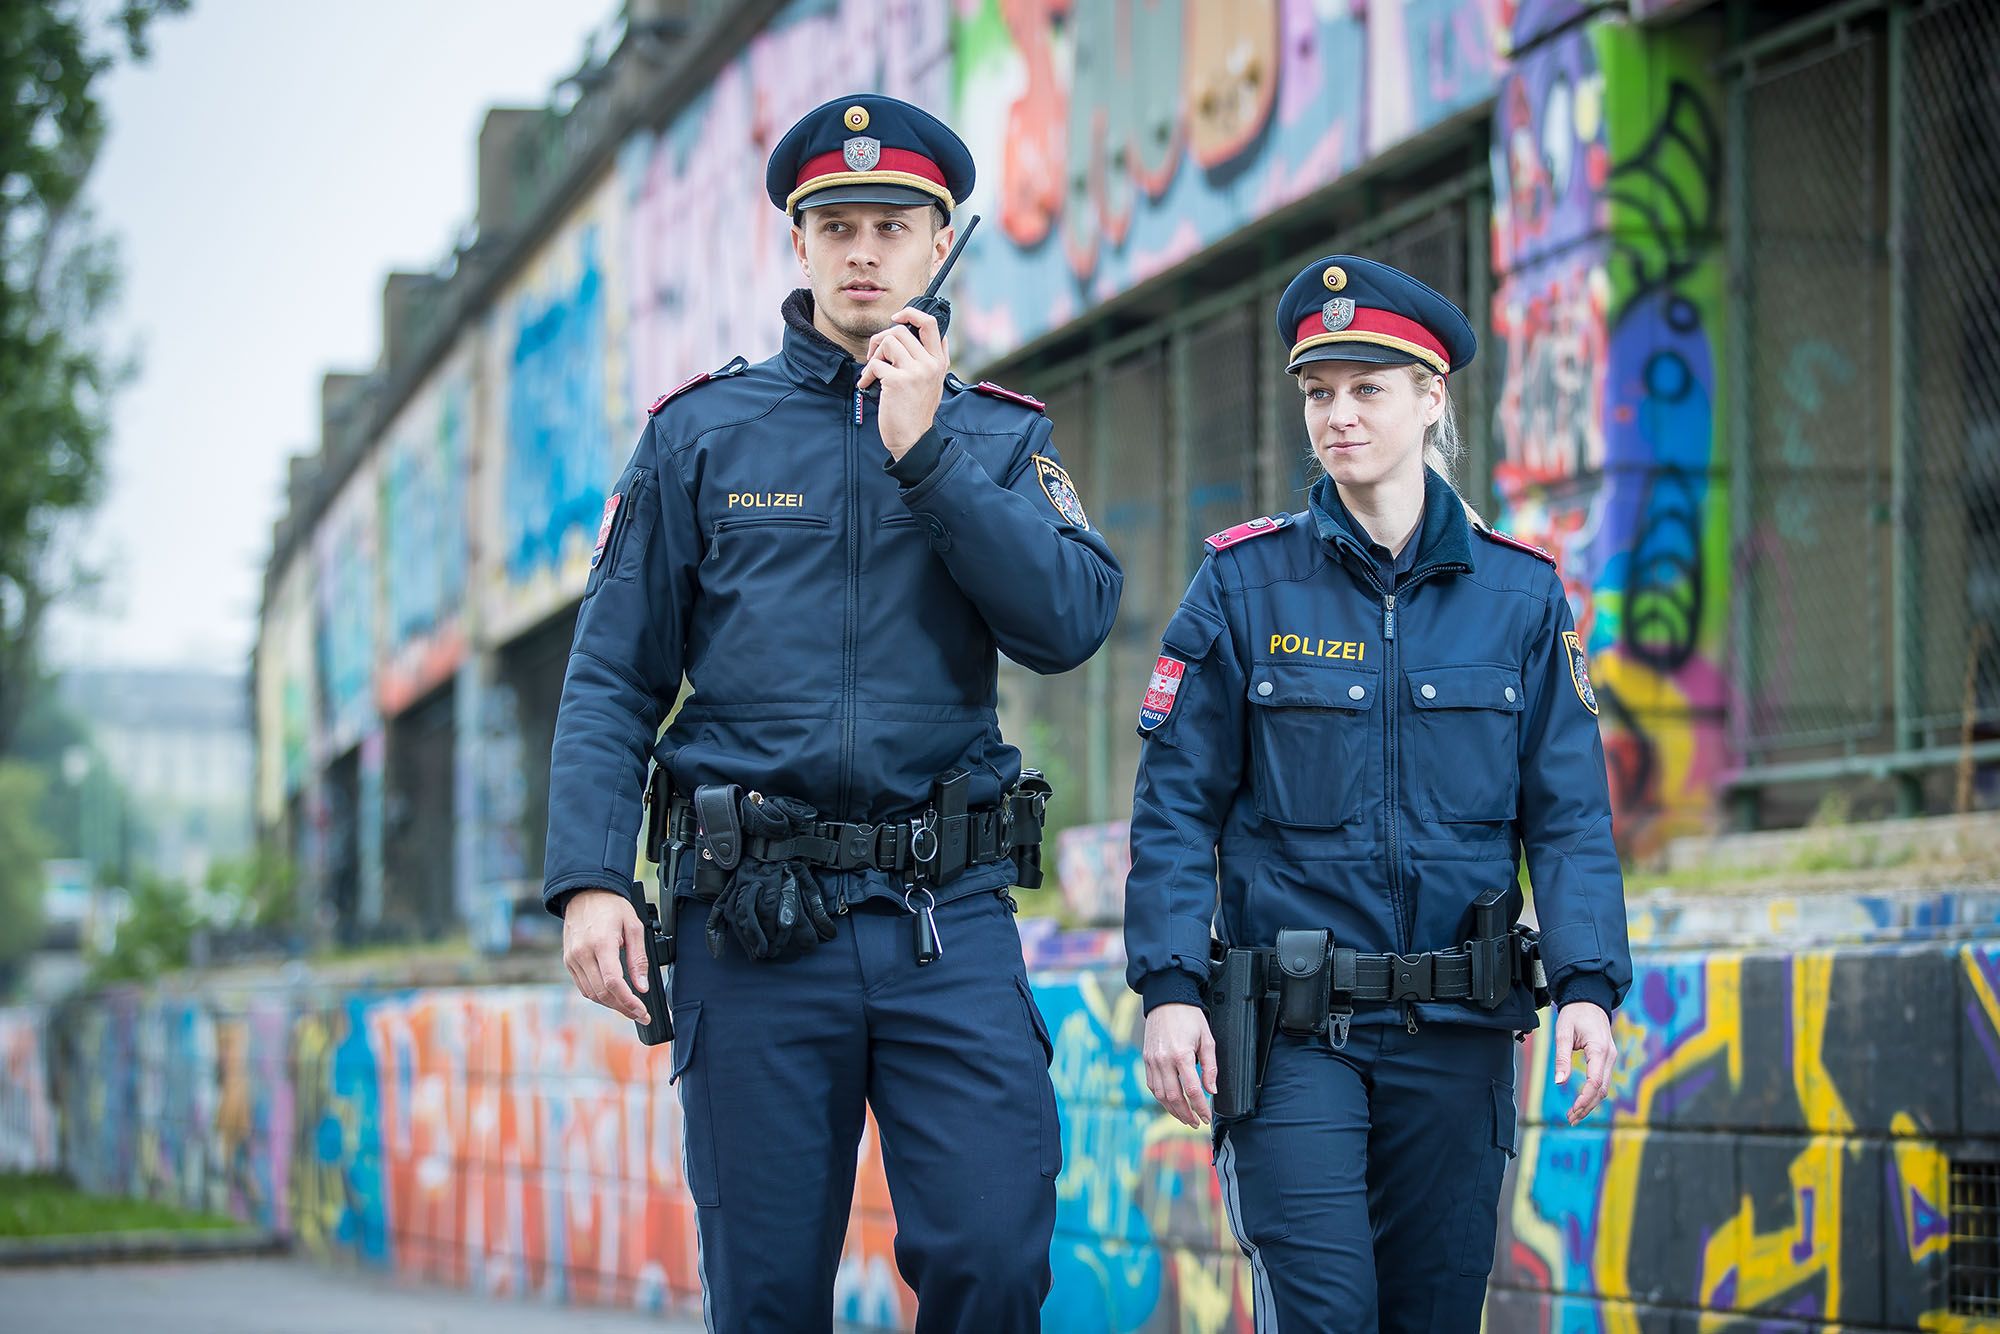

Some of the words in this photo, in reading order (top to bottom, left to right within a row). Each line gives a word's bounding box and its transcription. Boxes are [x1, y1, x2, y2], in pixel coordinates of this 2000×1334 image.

[728, 493, 804, 508] POLIZEI
[1270, 634, 1365, 661] POLIZEI
[1141, 709, 1164, 721] POLIZEI
